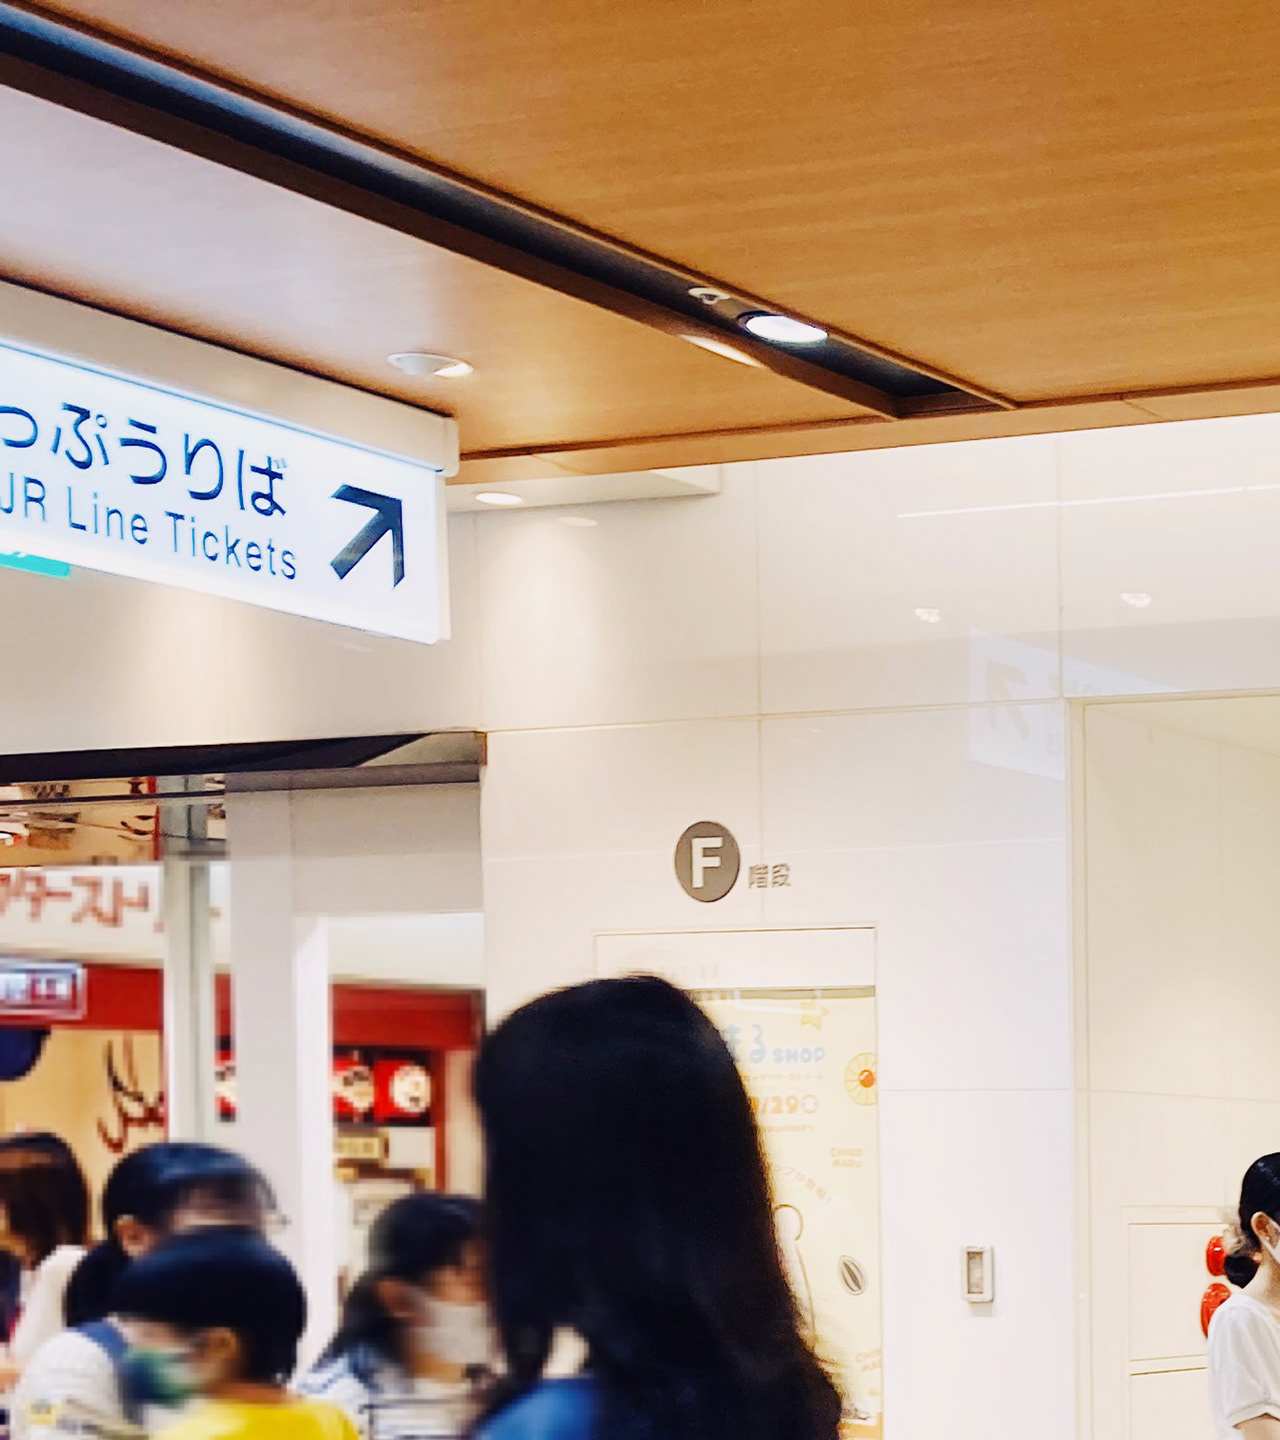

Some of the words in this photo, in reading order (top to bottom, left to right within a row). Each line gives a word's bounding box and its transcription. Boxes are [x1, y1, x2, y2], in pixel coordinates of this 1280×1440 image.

[0, 472, 47, 523] JR
[67, 485, 150, 545] Line
[164, 510, 298, 580] Tickets
[691, 836, 723, 889] F
